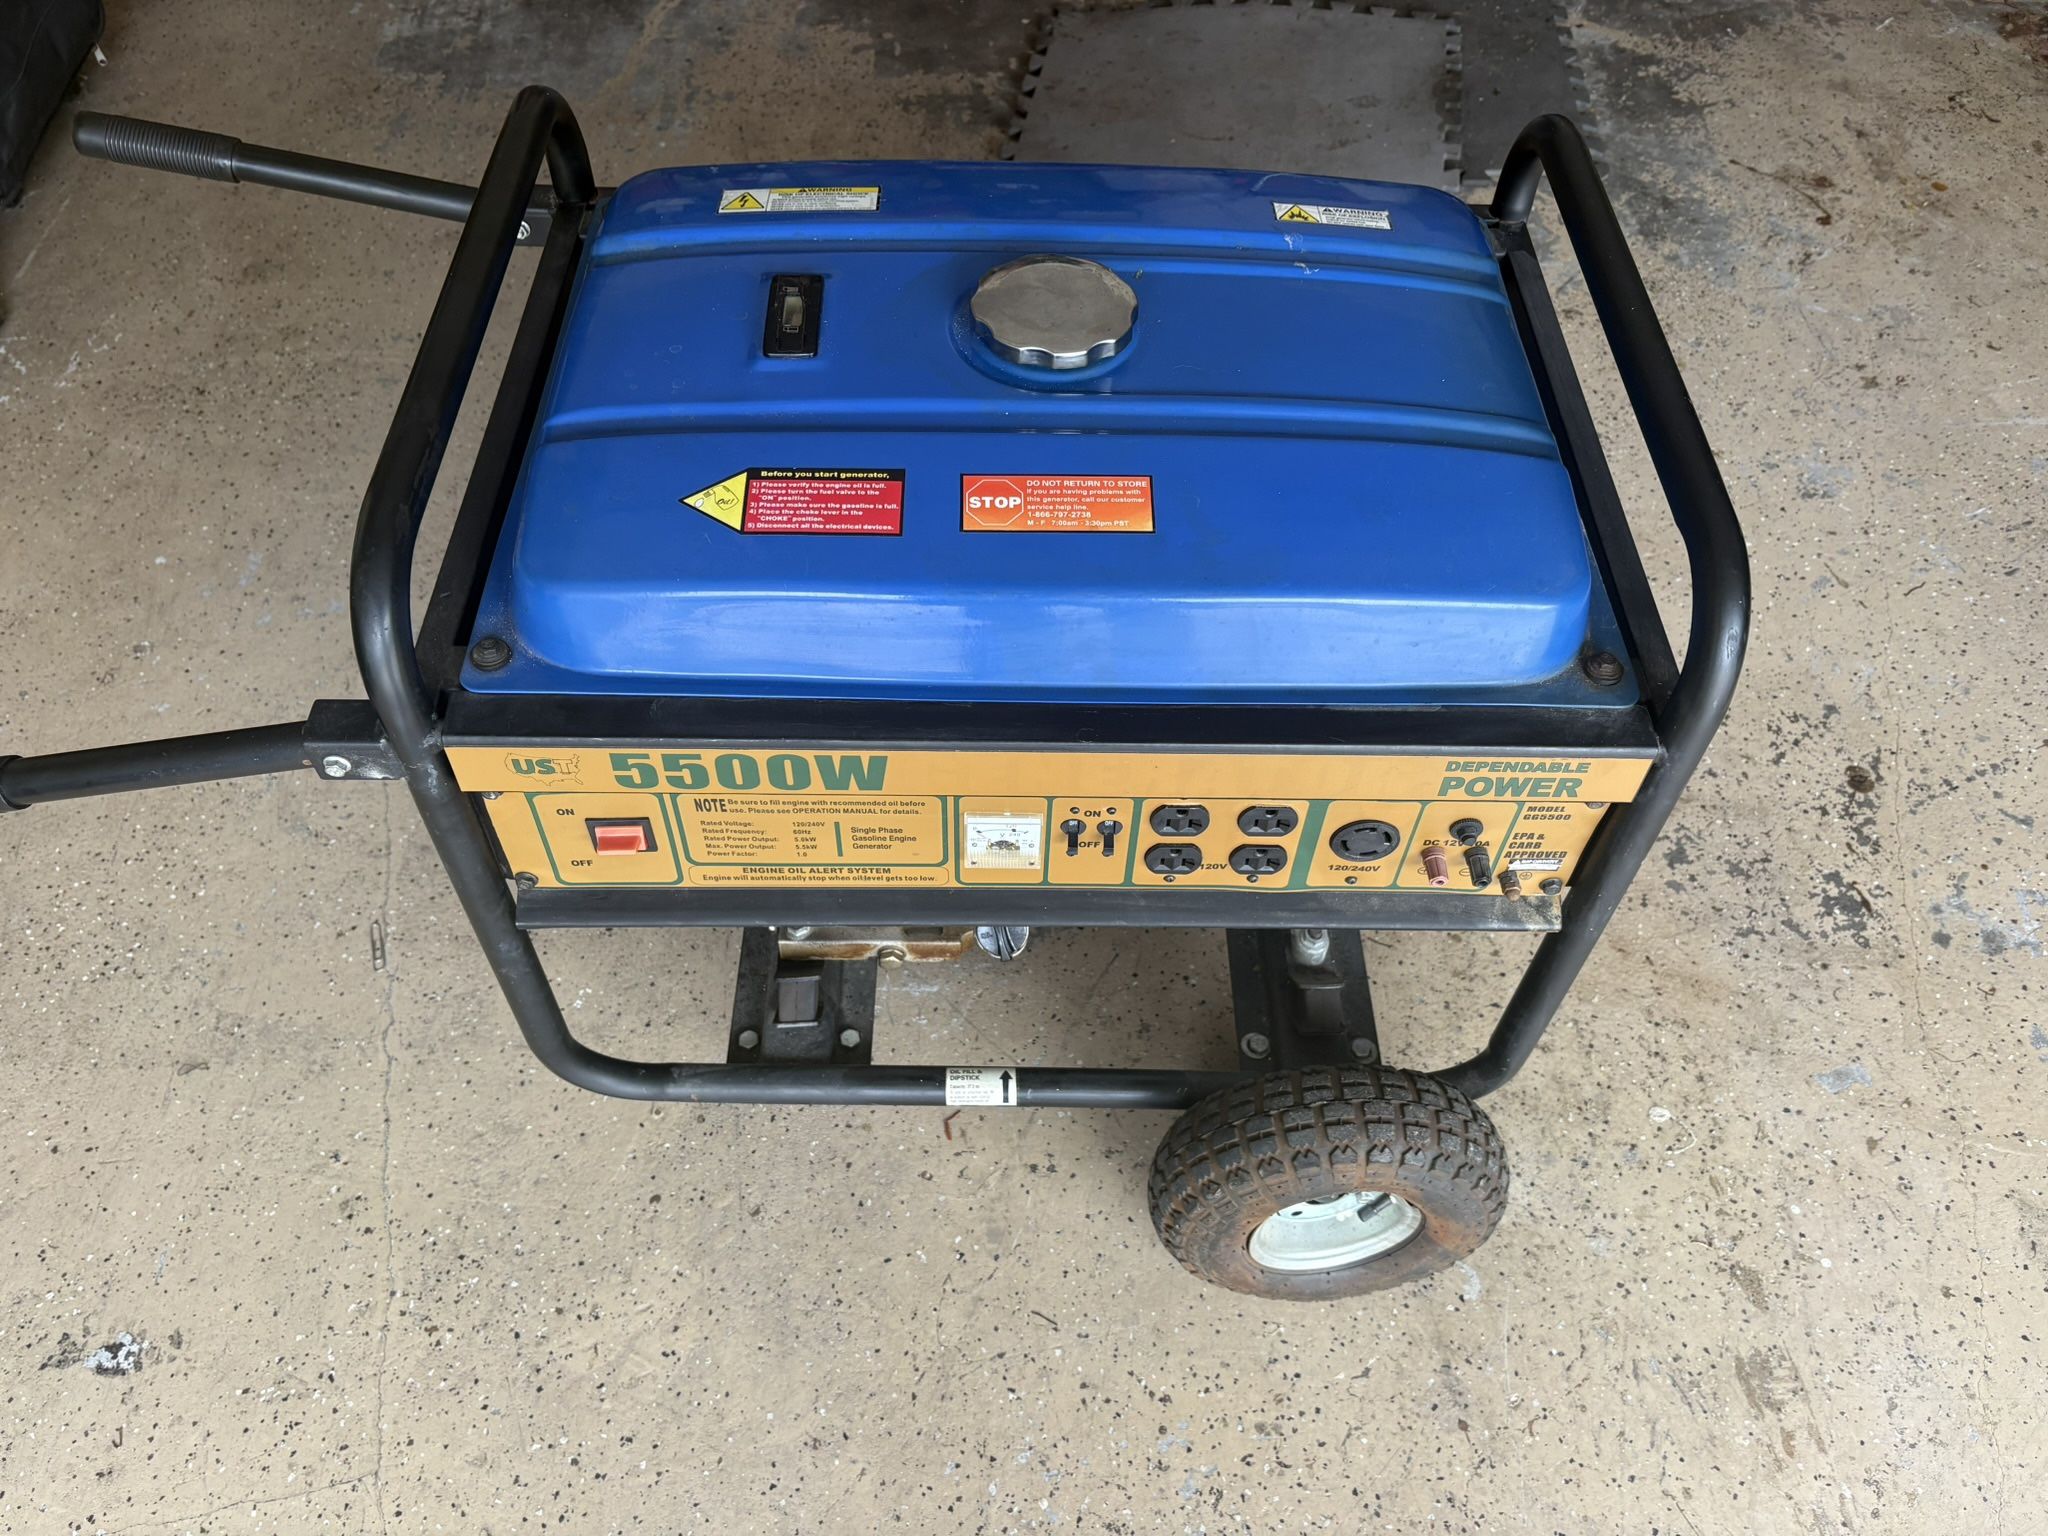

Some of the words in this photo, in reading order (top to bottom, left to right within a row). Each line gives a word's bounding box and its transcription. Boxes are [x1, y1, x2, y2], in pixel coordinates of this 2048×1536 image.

[1333, 208, 1384, 217] WARNING
[969, 496, 1022, 509] STOP
[511, 758, 574, 775] UST
[608, 753, 888, 791] 5500W
[1445, 761, 1591, 773] DEPENDABLE
[1438, 776, 1582, 798] POWER
[694, 798, 727, 812] NOTE
[556, 808, 575, 816] ON
[889, 835, 917, 843] Engine
[571, 859, 593, 867] OFF
